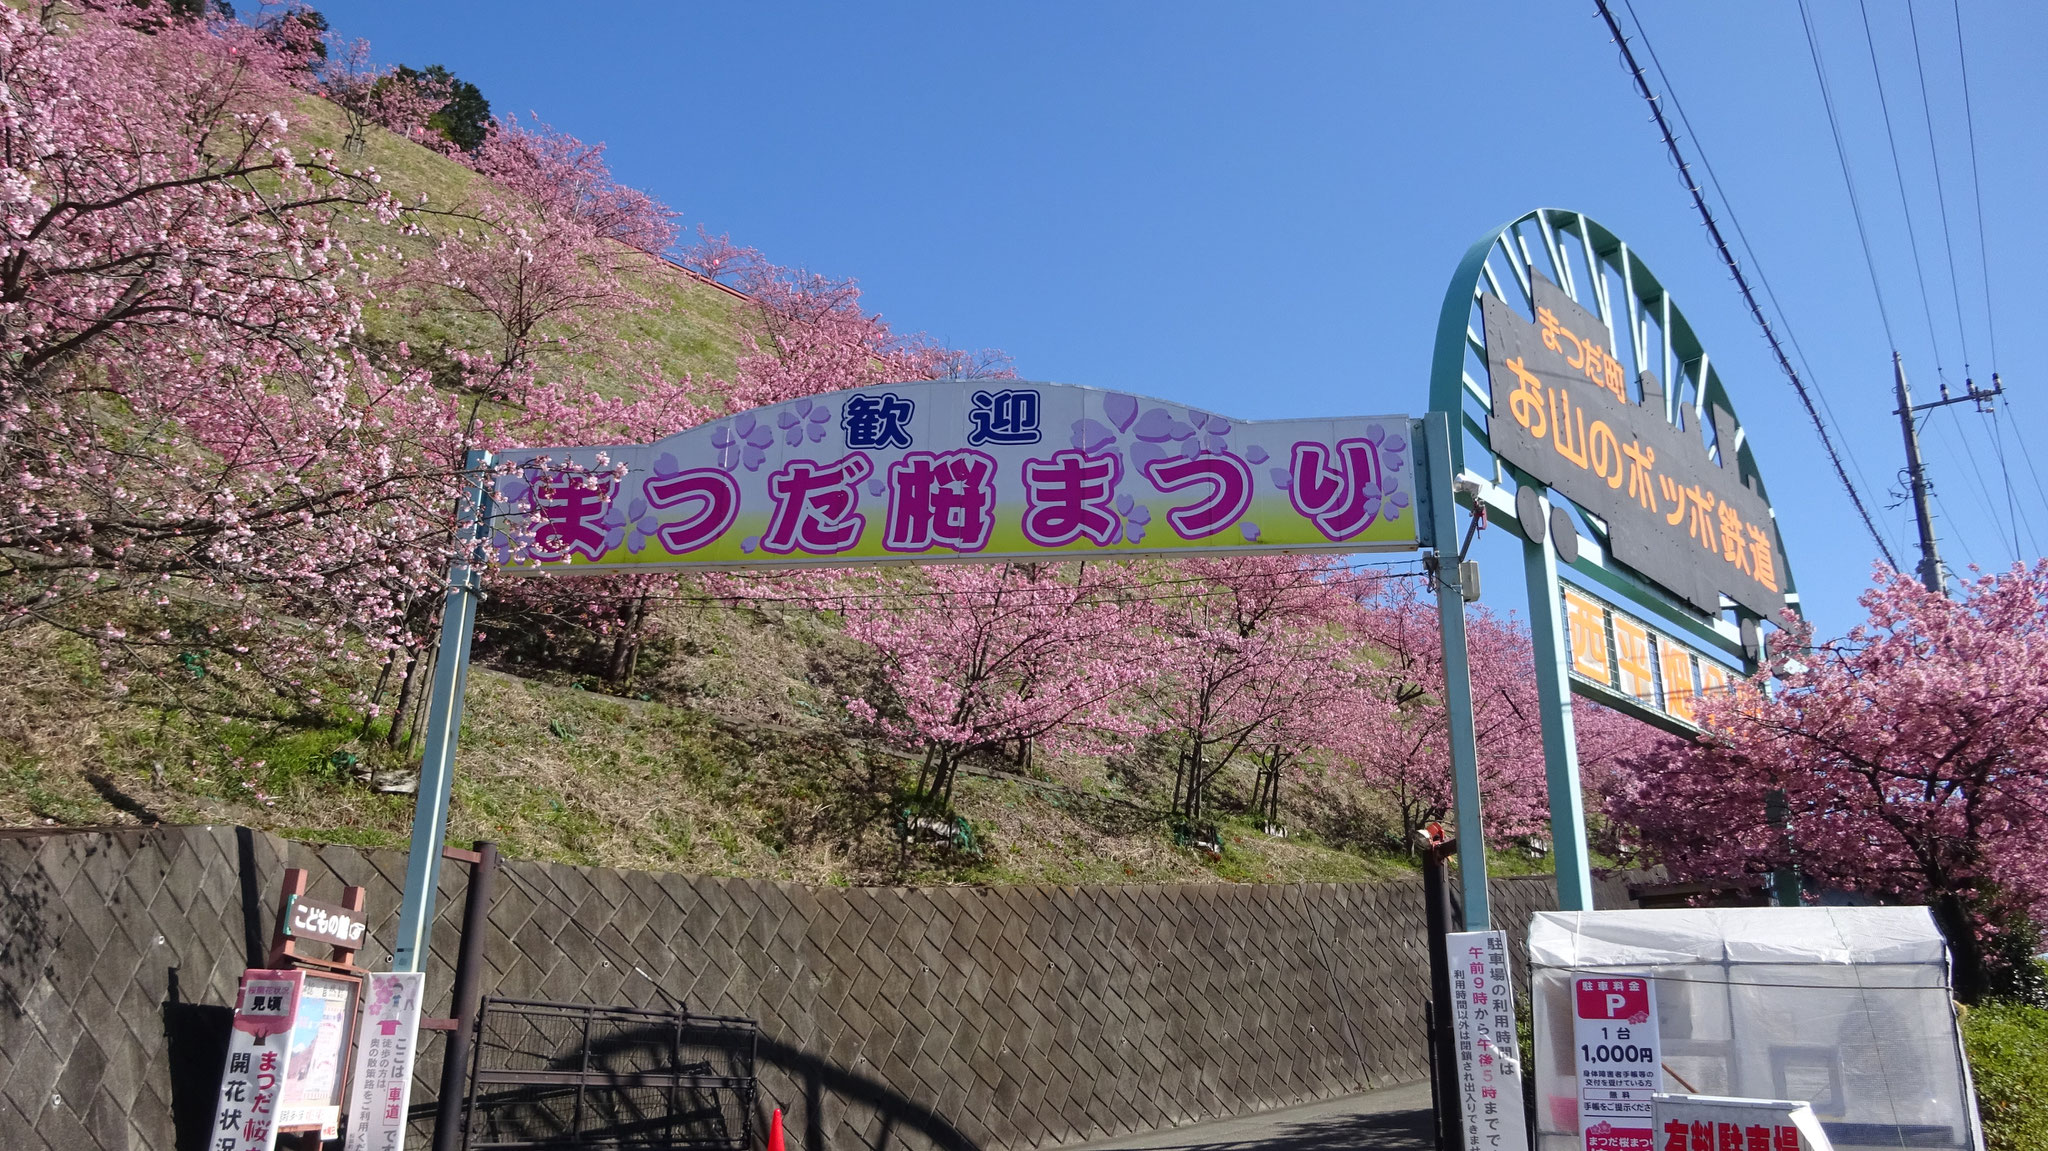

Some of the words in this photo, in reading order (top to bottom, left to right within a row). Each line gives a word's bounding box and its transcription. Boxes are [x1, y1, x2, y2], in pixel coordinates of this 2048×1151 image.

[1538, 306, 1626, 404] まつだ町
[843, 388, 1042, 450] 歓迎
[527, 439, 1380, 562] まつだ桜まつり
[1506, 356, 1778, 593] お山のポッポ鉄道
[1565, 588, 1764, 745] 西平畑
[251, 996, 283, 1011] 見頃
[1487, 937, 1514, 1075] 駐車場の利用時間は
[1582, 981, 1640, 991] 駐車料金
[1606, 993, 1626, 1017] P
[1468, 946, 1501, 1151] 午前9時から午後5時までで
[1581, 1044, 1653, 1064] 1,000円
[1583, 1070, 1654, 1078] 身体障害者手帳等の
[1585, 1079, 1652, 1087] 交付を受けている方
[215, 1053, 251, 1151] 開花状況
[242, 1051, 278, 1151] まつだ桜
[1609, 1091, 1630, 1099] 無料
